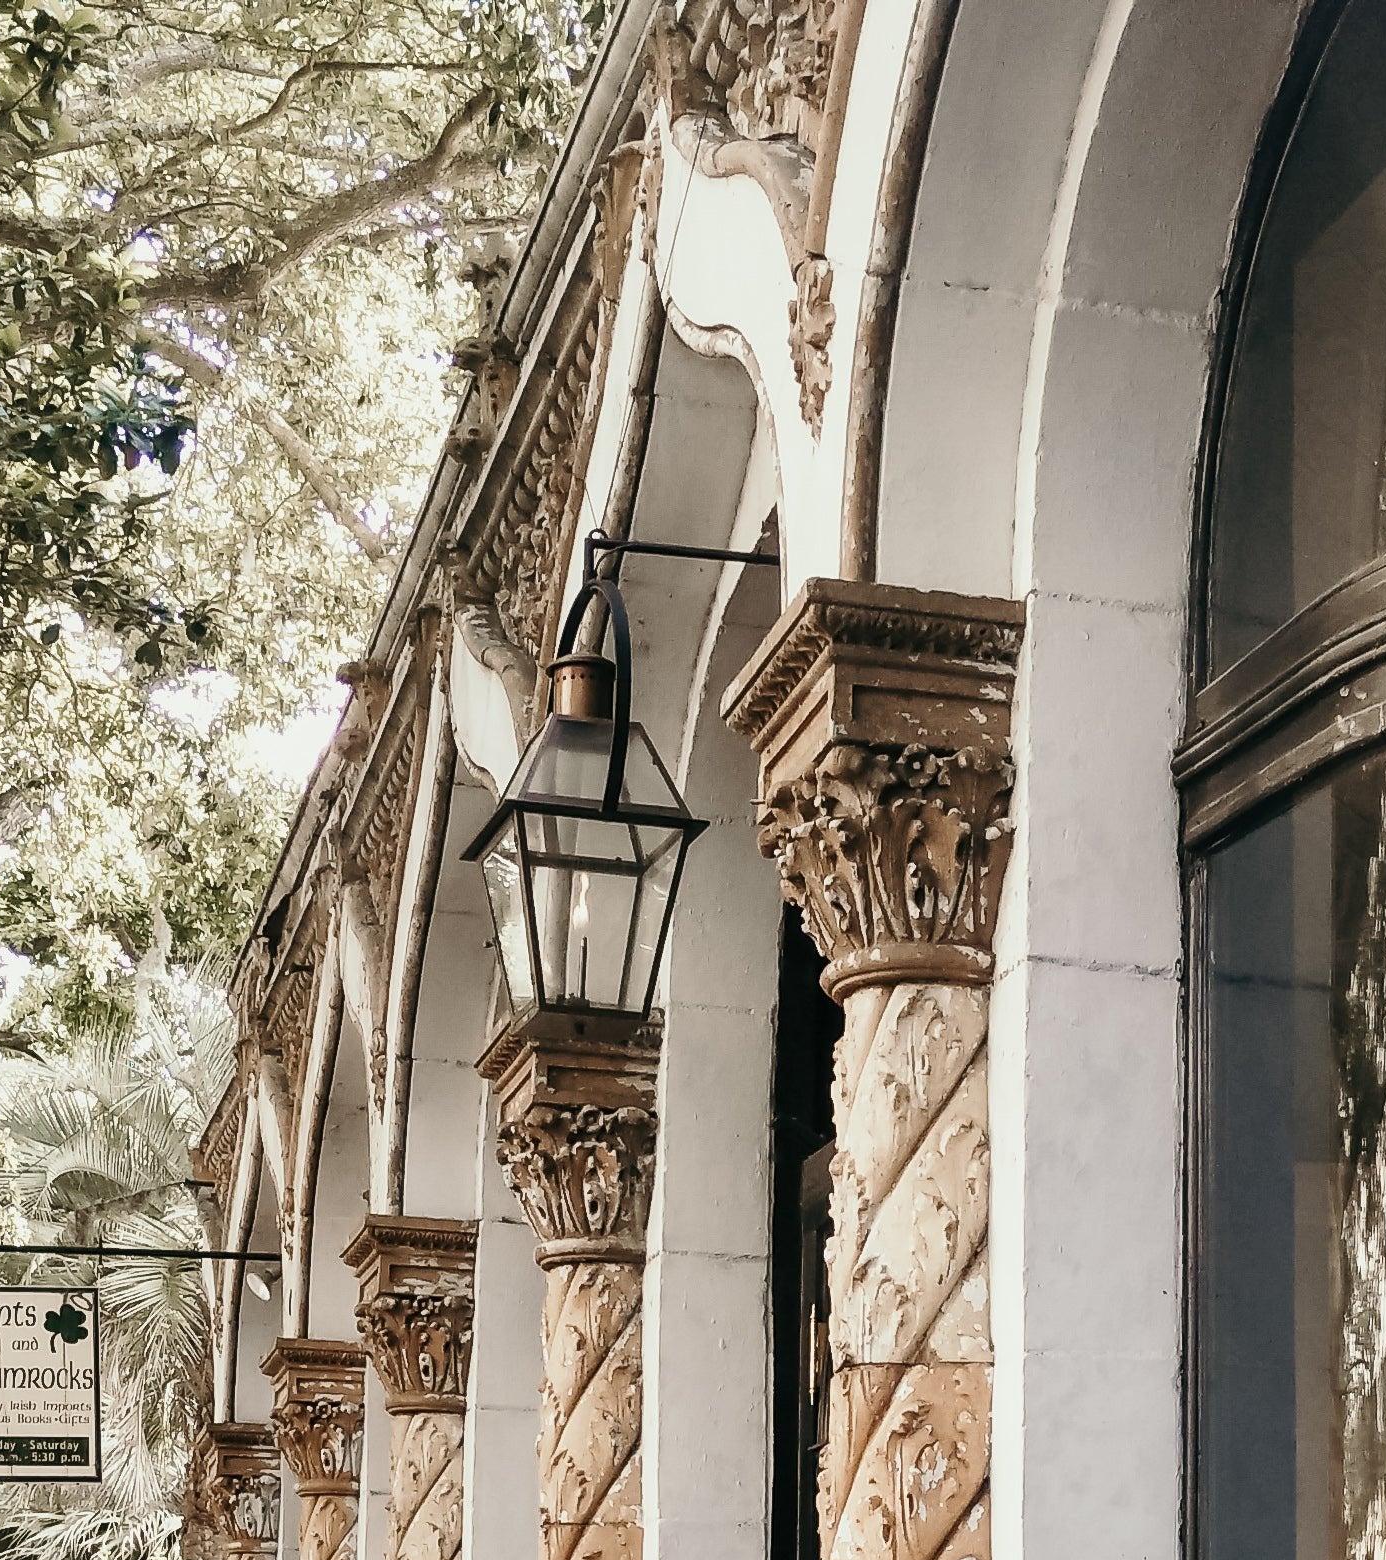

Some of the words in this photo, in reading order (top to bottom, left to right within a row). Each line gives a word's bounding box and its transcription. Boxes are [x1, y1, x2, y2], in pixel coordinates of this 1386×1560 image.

[11, 1336, 39, 1351] and
[43, 1399, 92, 1414] Imports
[17, 1413, 53, 1424] Books
[29, 1439, 80, 1452] Saturday
[31, 1451, 56, 1462] 5:30
[60, 1453, 85, 1464] p.m.
